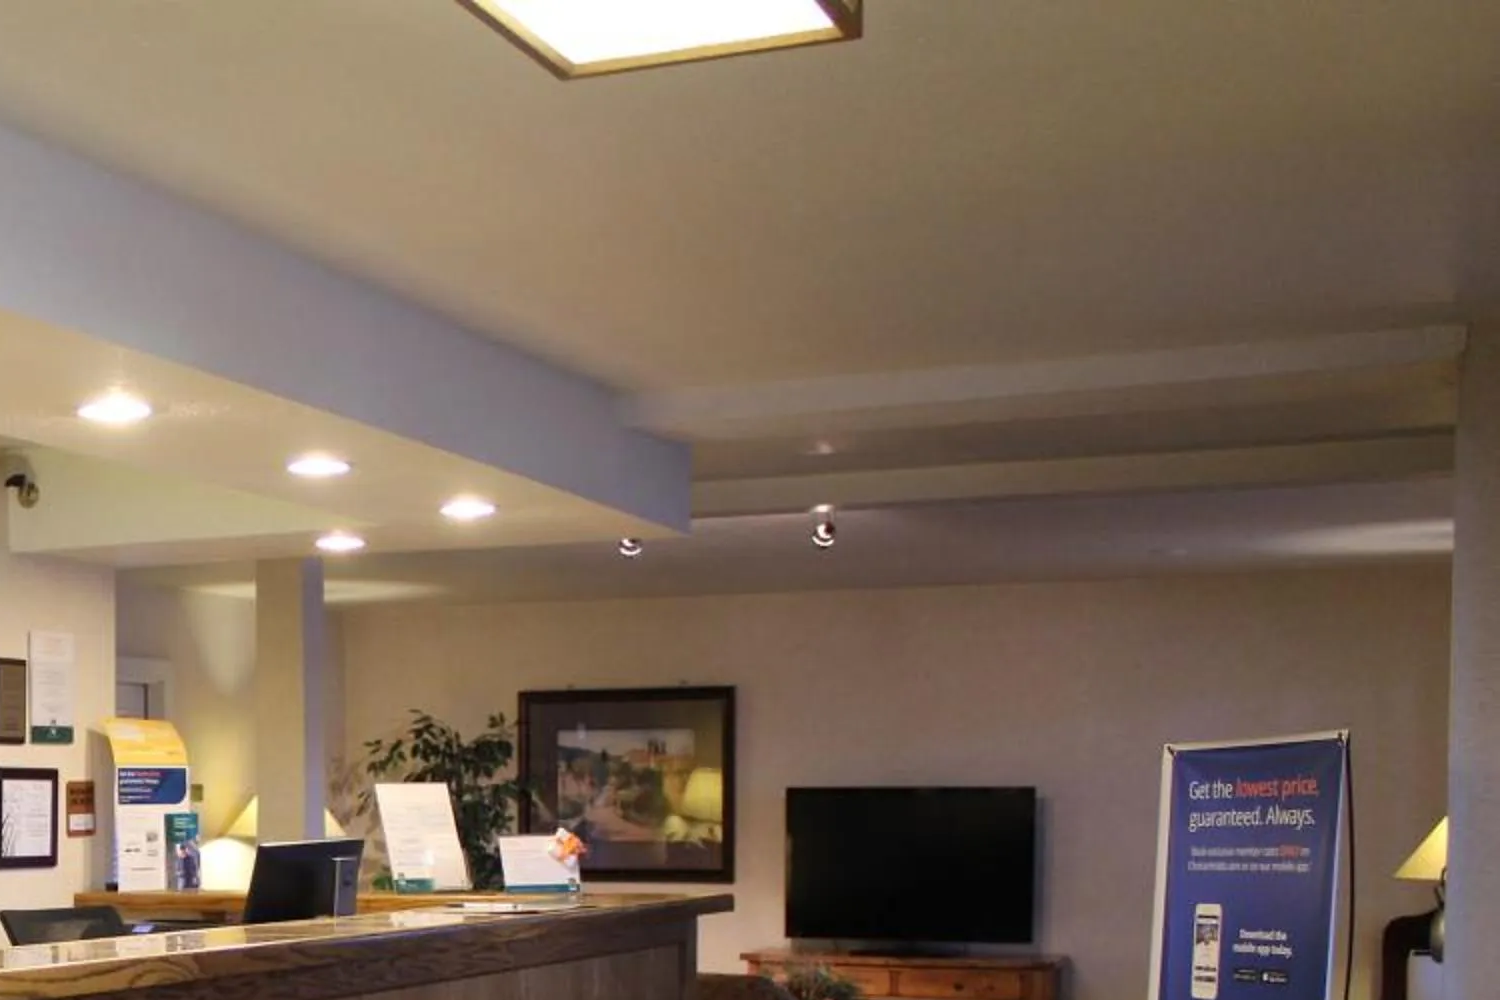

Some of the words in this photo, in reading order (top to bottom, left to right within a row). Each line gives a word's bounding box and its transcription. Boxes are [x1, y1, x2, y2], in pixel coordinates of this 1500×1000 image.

[1189, 780, 1211, 800] Get
[1211, 778, 1233, 799] the
[1235, 777, 1279, 798] lowest
[1188, 806, 1263, 833] guaranteed.
[1265, 805, 1316, 831] Always.
